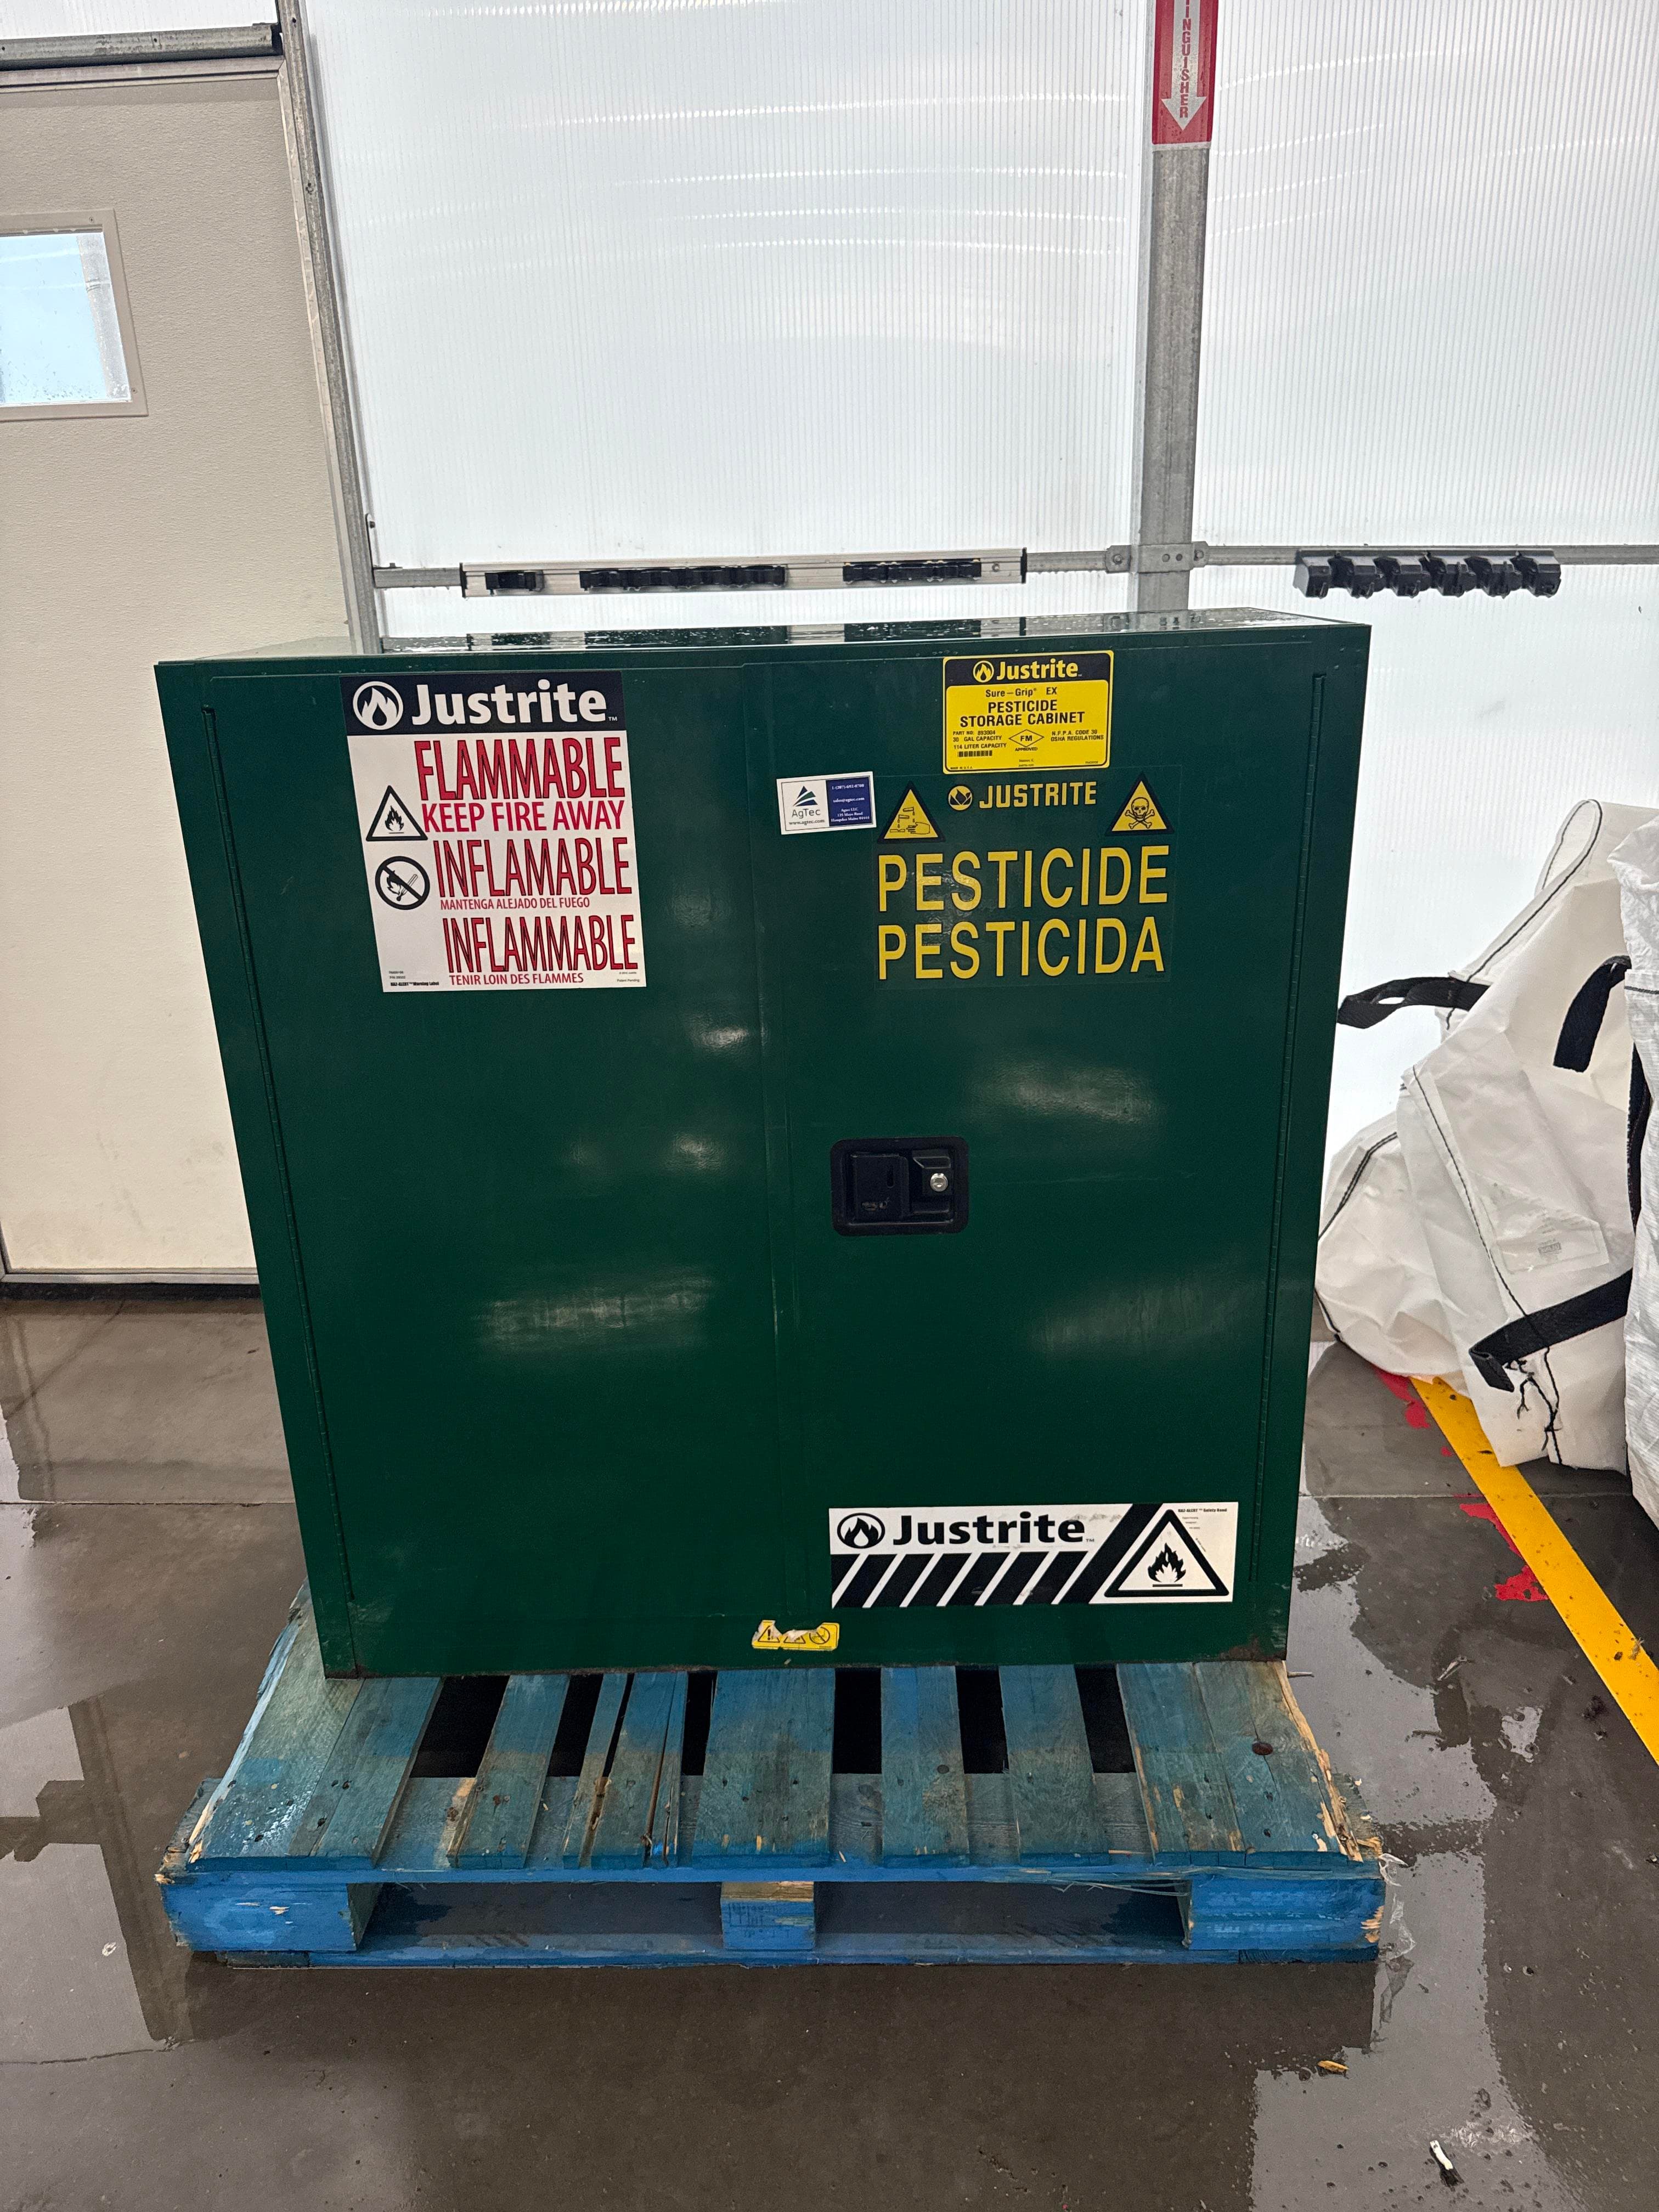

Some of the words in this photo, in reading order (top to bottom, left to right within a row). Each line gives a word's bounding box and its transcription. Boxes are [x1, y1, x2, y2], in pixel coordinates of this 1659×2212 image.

[996, 658, 1079, 680] Justrite
[412, 679, 607, 725] Justrite
[988, 699, 1058, 713] PESTICIDE
[1046, 687, 1058, 695] EX
[960, 714, 1022, 727] STORAGE
[1028, 712, 1085, 725] CABINET
[414, 737, 625, 800] FLAMMABLE
[979, 781, 1097, 809] JUSTRITE
[422, 804, 485, 833] KEEP
[492, 802, 547, 831] FIRE
[553, 800, 625, 831] AWAY
[792, 808, 821, 819] AgTec
[433, 837, 632, 898] INFLAMABLE
[878, 845, 1170, 912] PESTICIDE
[441, 899, 494, 910] MANTENGA
[496, 898, 538, 909] ALEJADO
[540, 898, 557, 908] DEL
[559, 897, 590, 908] FUEGO
[442, 915, 637, 973] INFLAMMABLE
[878, 916, 1165, 980] PESTICIDA
[449, 975, 481, 985] TENIR
[483, 974, 507, 984] LOIN
[511, 974, 530, 984] DES
[533, 973, 584, 983] FLAMMES
[893, 1511, 1085, 1545] Justrite
